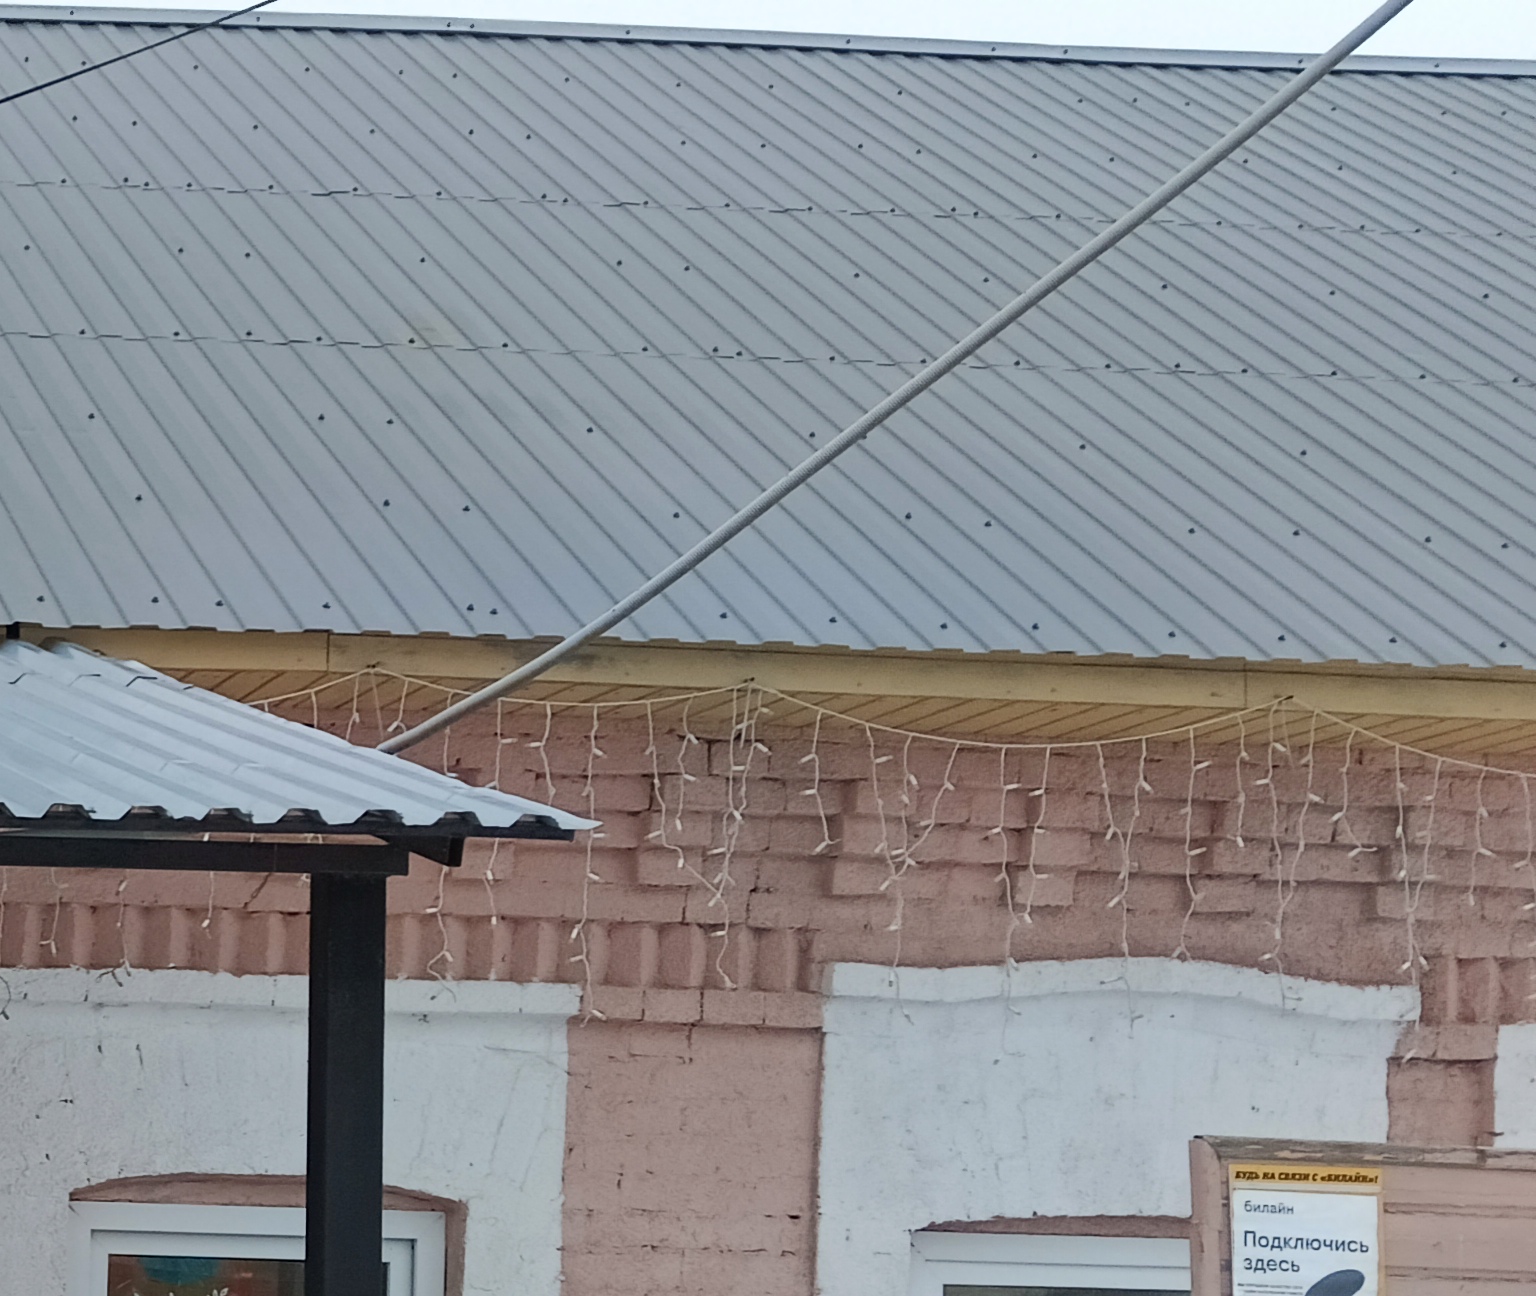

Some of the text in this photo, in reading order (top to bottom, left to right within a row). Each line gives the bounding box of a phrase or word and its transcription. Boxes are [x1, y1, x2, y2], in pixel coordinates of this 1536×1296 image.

[1234, 1170, 1261, 1182] БУДЬ
[1261, 1171, 1276, 1181] НА
[1311, 1172, 1319, 1182] С
[1244, 1200, 1295, 1215] билайн
[1243, 1230, 1370, 1254] Подключись
[1243, 1257, 1301, 1274] здесь
